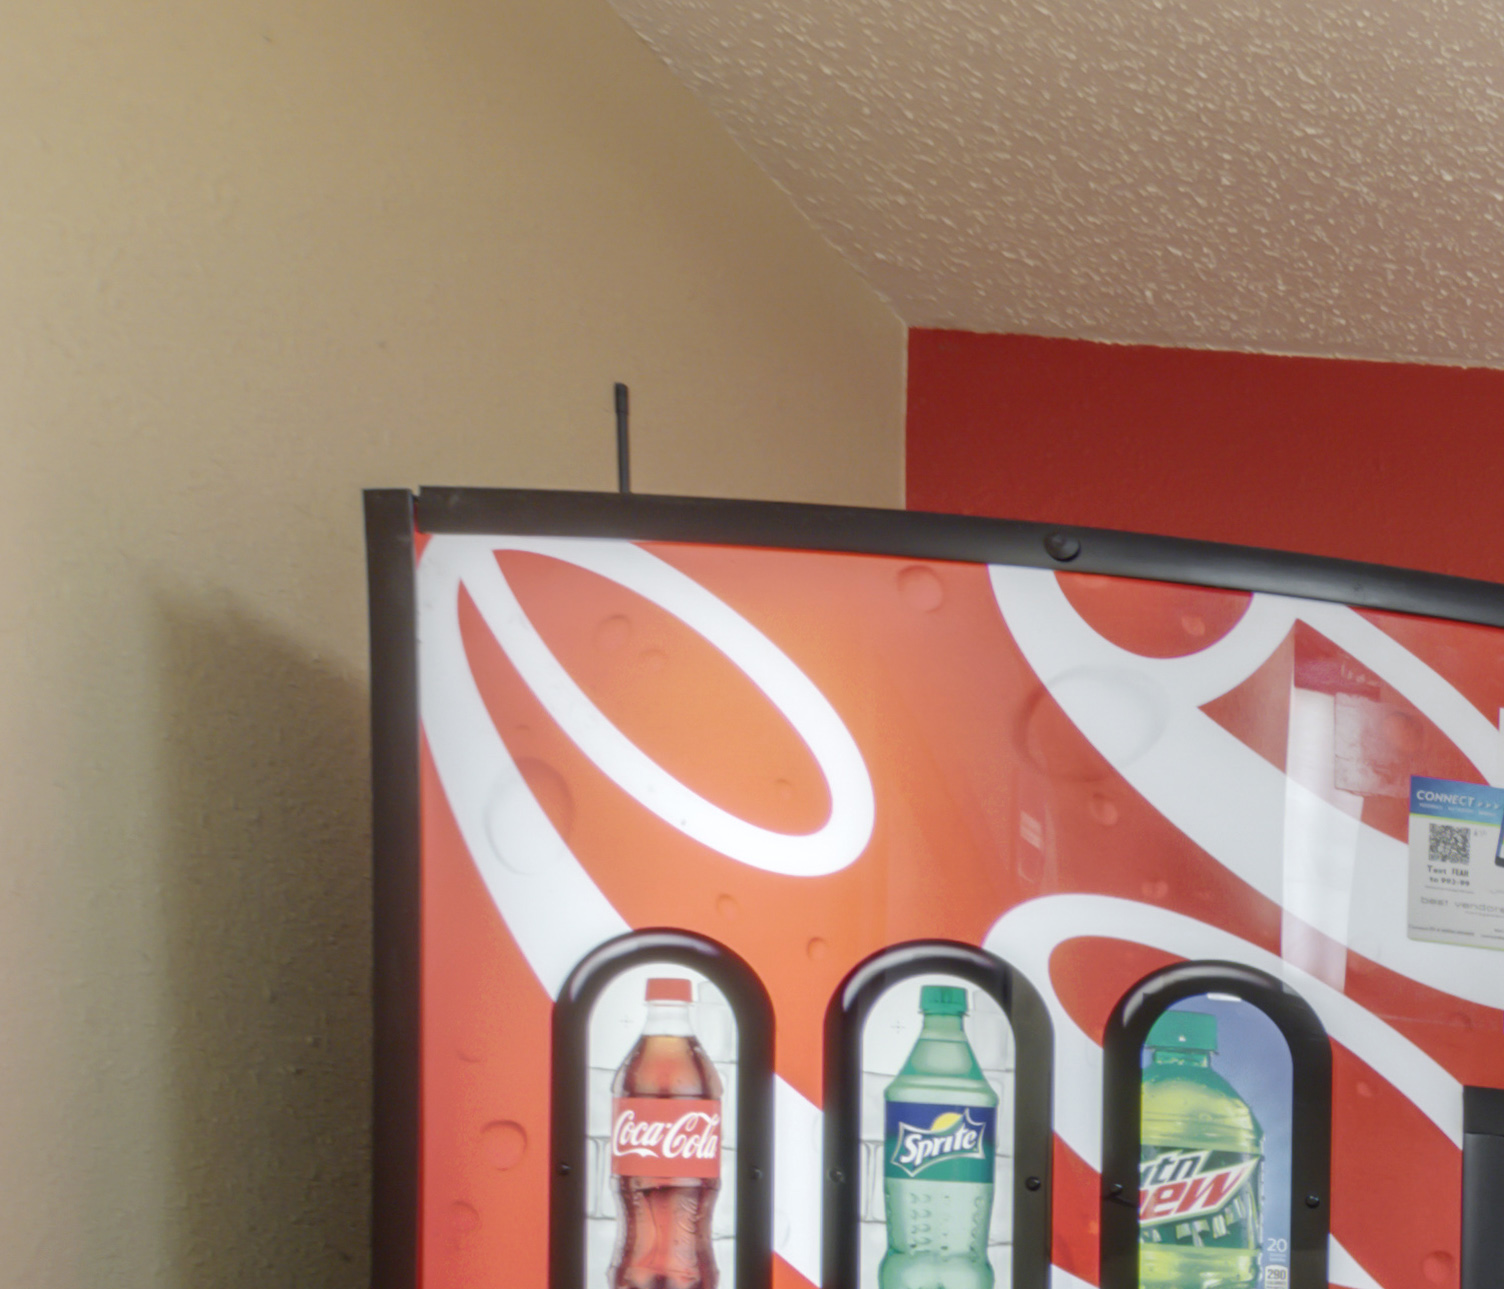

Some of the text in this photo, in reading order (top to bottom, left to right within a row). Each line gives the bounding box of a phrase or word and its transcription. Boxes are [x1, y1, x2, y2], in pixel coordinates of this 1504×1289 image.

[1416, 790, 1475, 808] CONNECT
[613, 1109, 721, 1159] Coca-Cola
[899, 1126, 978, 1168] Sprite
[1267, 1238, 1287, 1253] 20
[1267, 1269, 1286, 1280] 290
